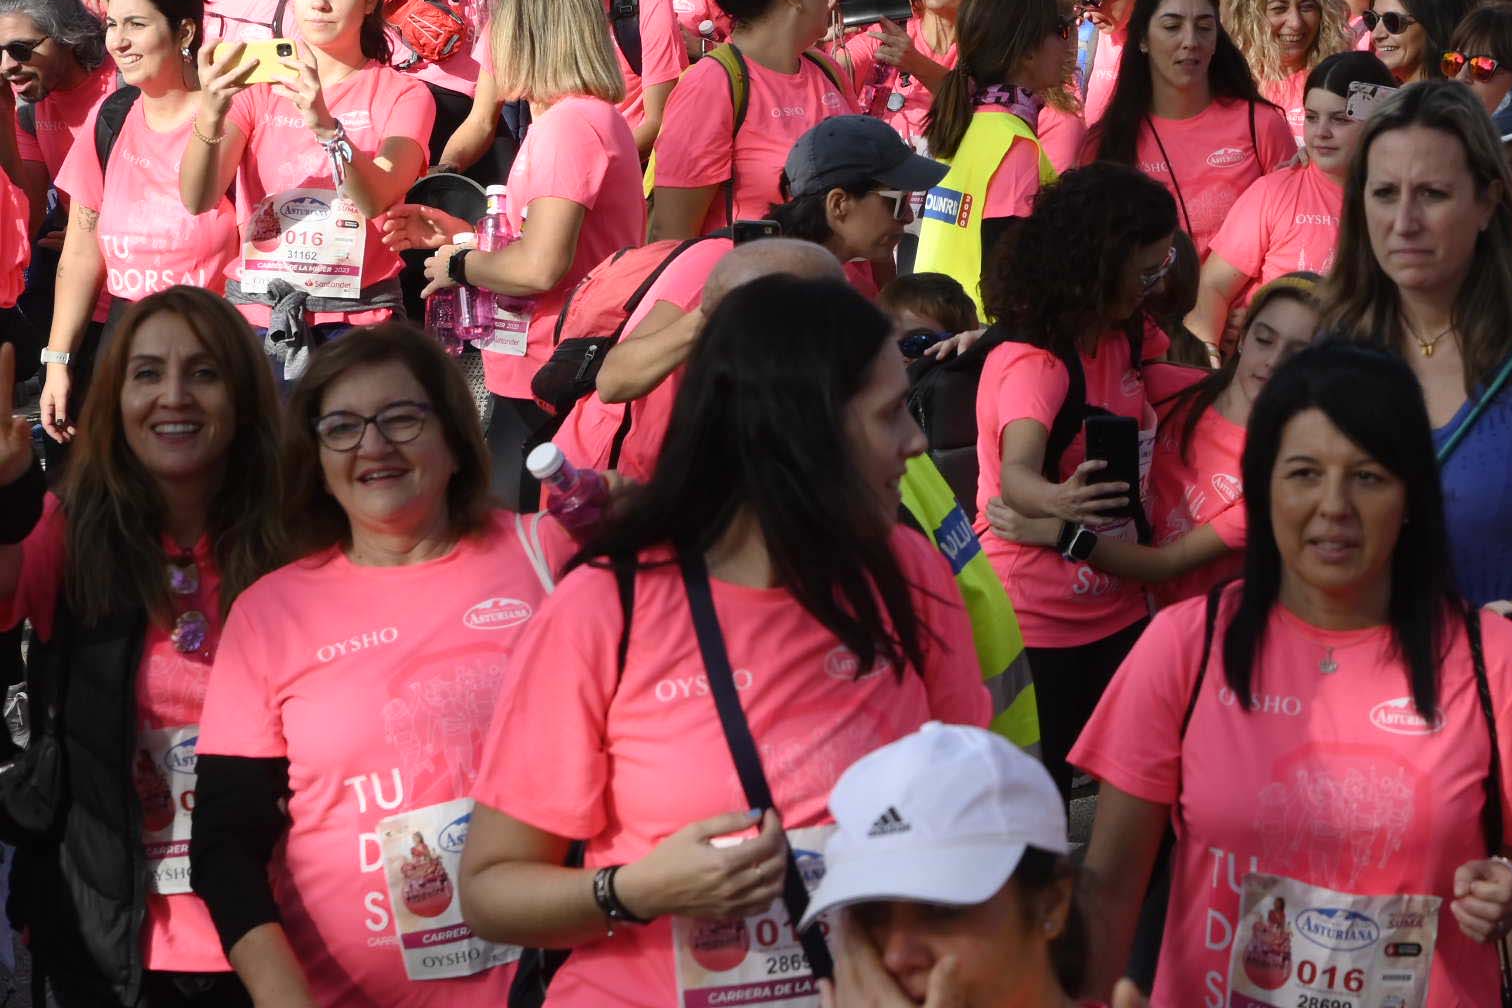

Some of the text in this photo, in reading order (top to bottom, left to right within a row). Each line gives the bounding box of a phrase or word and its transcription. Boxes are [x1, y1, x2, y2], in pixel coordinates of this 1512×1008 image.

[101, 236, 129, 258] TU
[285, 230, 324, 247] 016
[287, 249, 318, 261] 31162
[314, 279, 352, 289] Santander
[470, 608, 528, 625] ASTURIANA
[316, 626, 399, 663] OYSHO
[655, 668, 753, 702] OYSO
[1218, 686, 1302, 717] OSHO
[343, 767, 405, 814] TU
[1302, 915, 1374, 942] ASTURIANA
[422, 947, 480, 969] OYSHO
[1297, 959, 1365, 993] 016
[707, 979, 811, 1004] CARRERA DE LA
